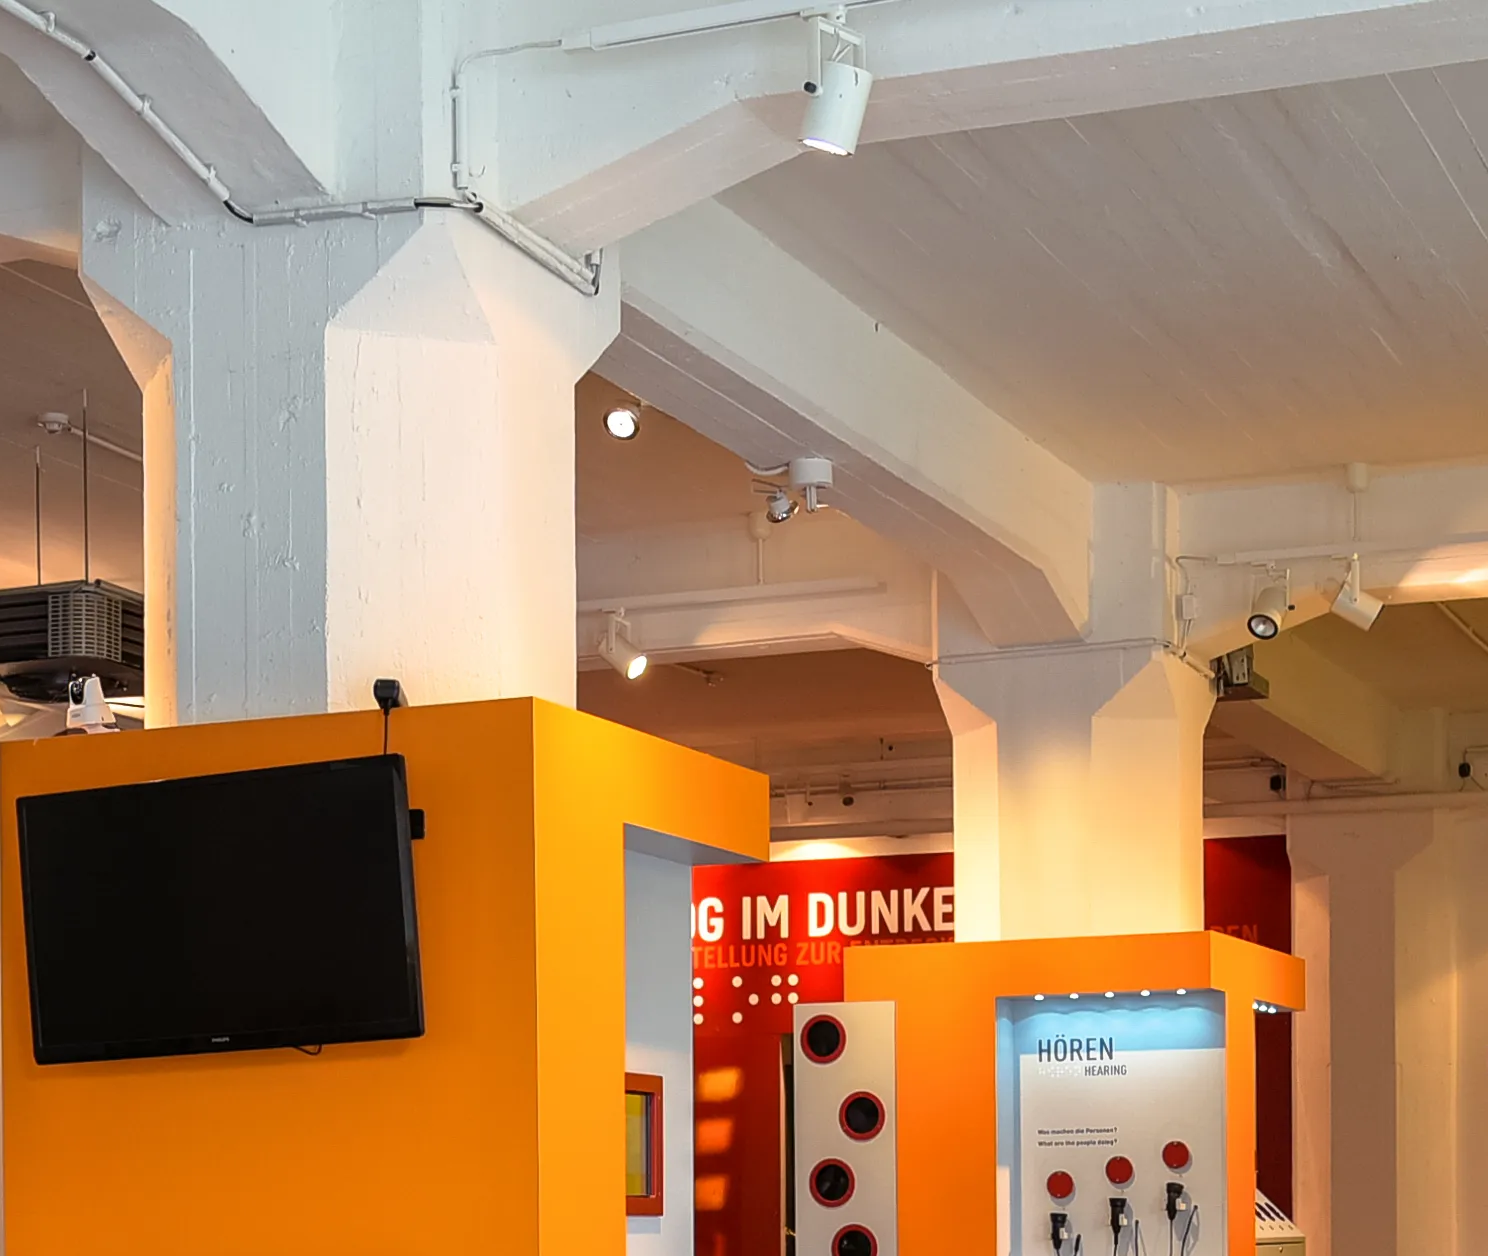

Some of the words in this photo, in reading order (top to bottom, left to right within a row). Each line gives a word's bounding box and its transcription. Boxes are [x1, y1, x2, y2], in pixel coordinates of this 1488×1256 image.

[742, 895, 789, 940] IM
[808, 886, 954, 938] DUNKE
[796, 938, 841, 966] ZUR
[1038, 1034, 1114, 1062] HÖREN
[1084, 1065, 1127, 1076] HEARING
